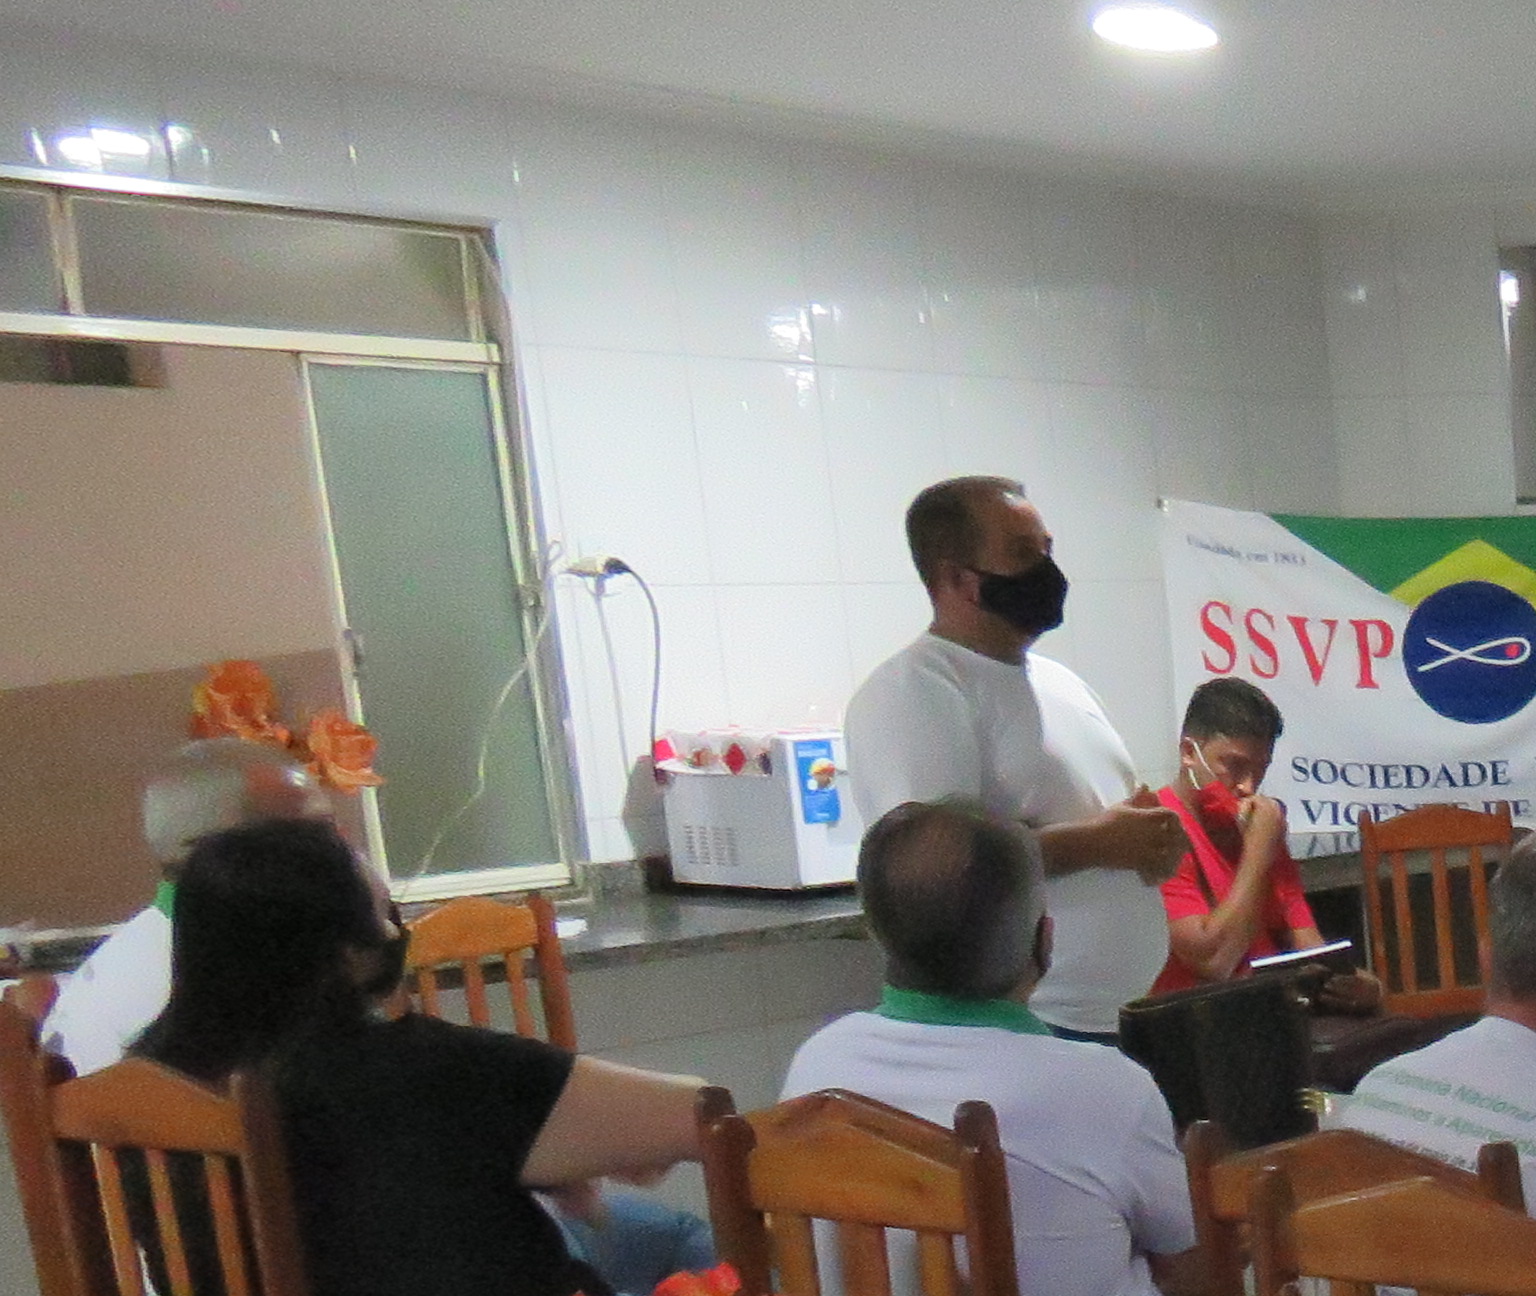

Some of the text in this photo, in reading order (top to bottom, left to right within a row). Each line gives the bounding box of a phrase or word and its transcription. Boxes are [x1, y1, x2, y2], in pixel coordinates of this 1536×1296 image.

[1200, 600, 1395, 689] SSVP
[1291, 756, 1511, 789] SOCIEDADE
[1300, 799, 1470, 826] VICE
